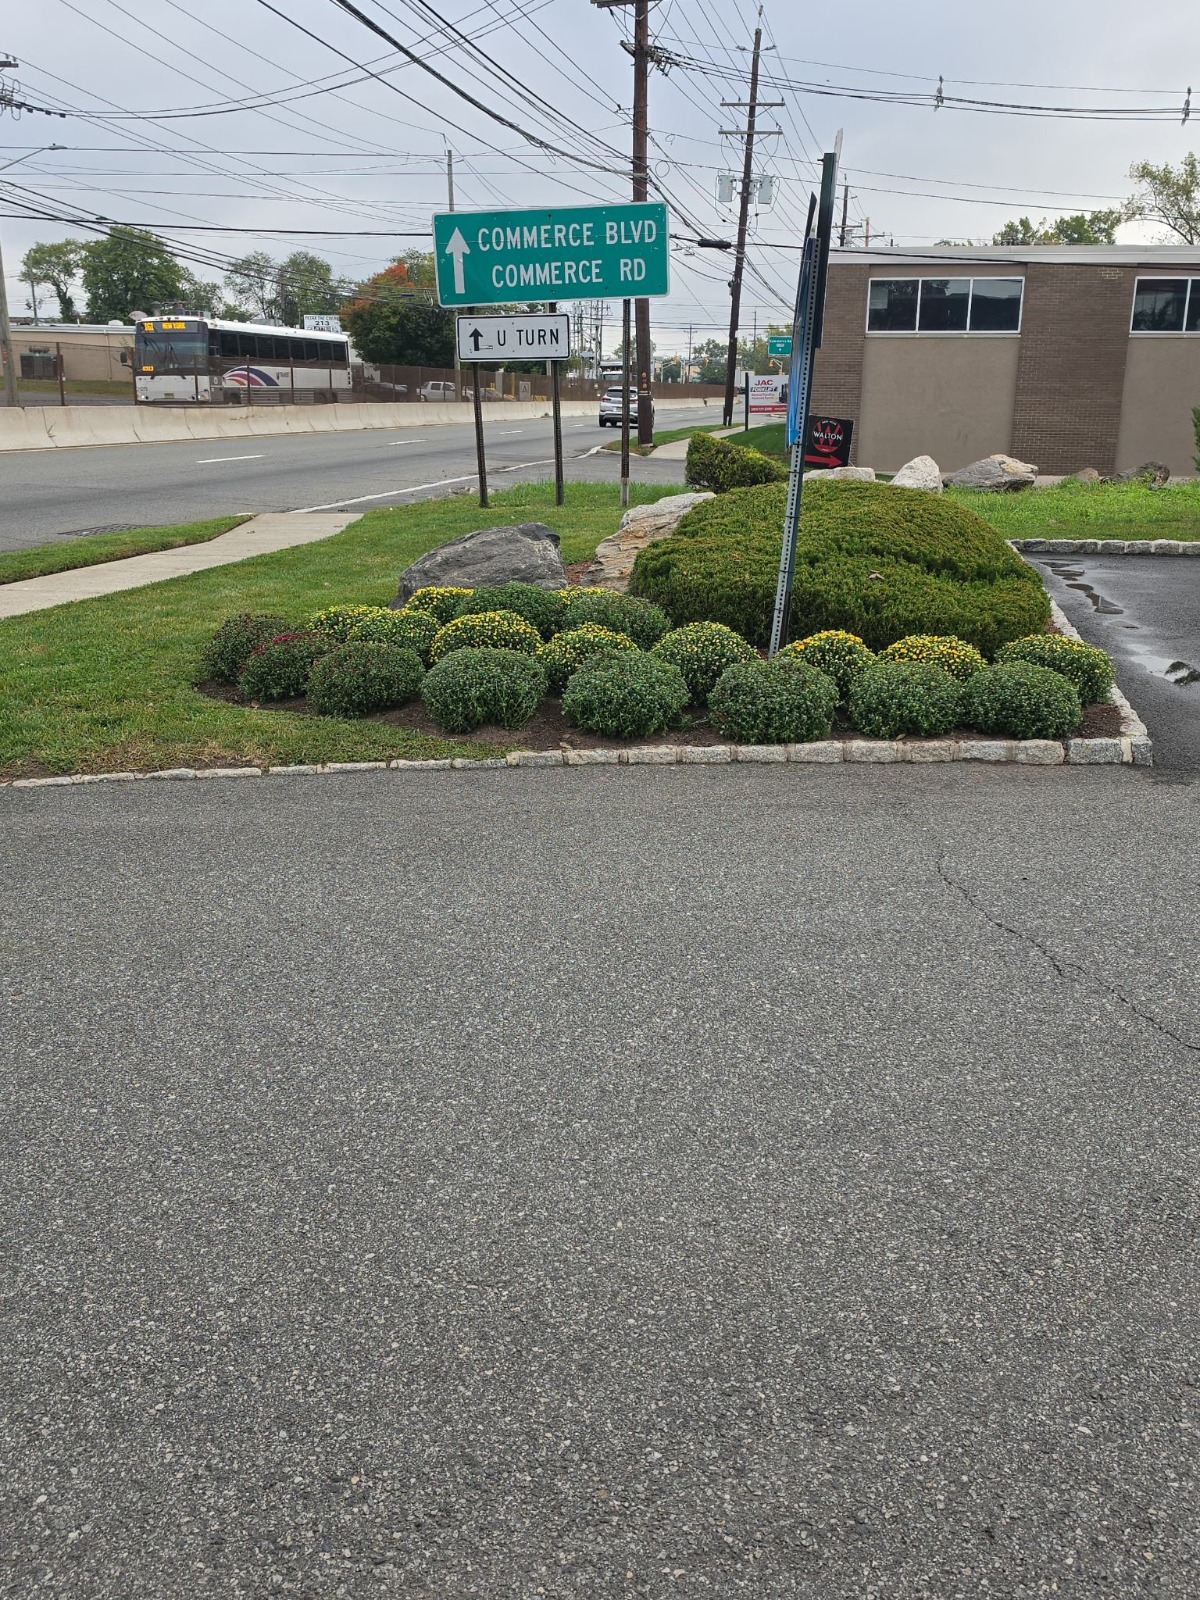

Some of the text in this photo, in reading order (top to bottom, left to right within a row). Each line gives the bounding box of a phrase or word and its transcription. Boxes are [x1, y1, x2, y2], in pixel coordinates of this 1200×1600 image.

[478, 220, 657, 251] COMMERCE BLVD
[492, 258, 646, 288] COMMERCE RD
[497, 328, 559, 346] U TURN
[813, 431, 842, 440] WALTON
